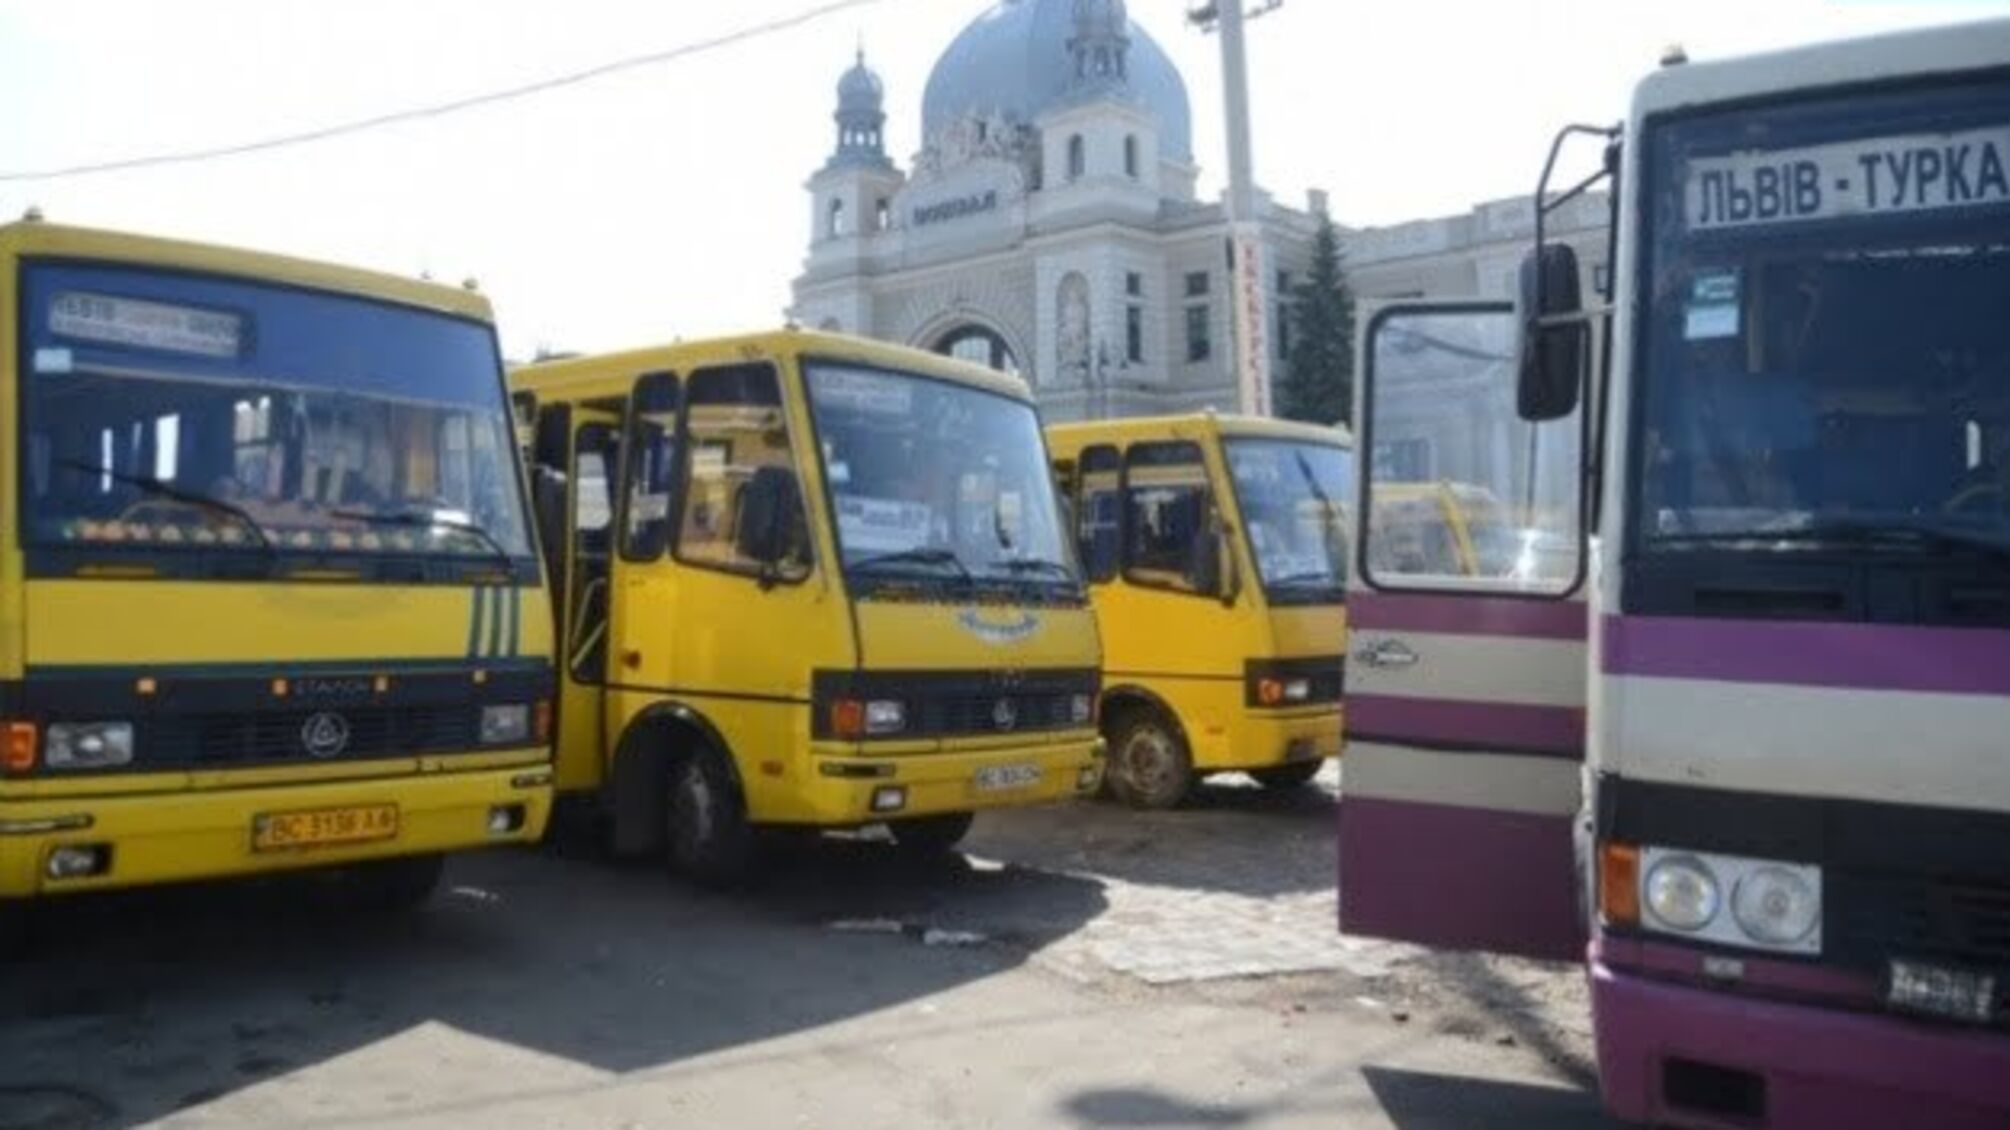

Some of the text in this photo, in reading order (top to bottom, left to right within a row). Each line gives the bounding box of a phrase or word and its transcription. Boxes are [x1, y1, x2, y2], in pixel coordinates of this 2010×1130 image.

[1700, 140, 2009, 223] ЛЬВІВ - ТУРКА
